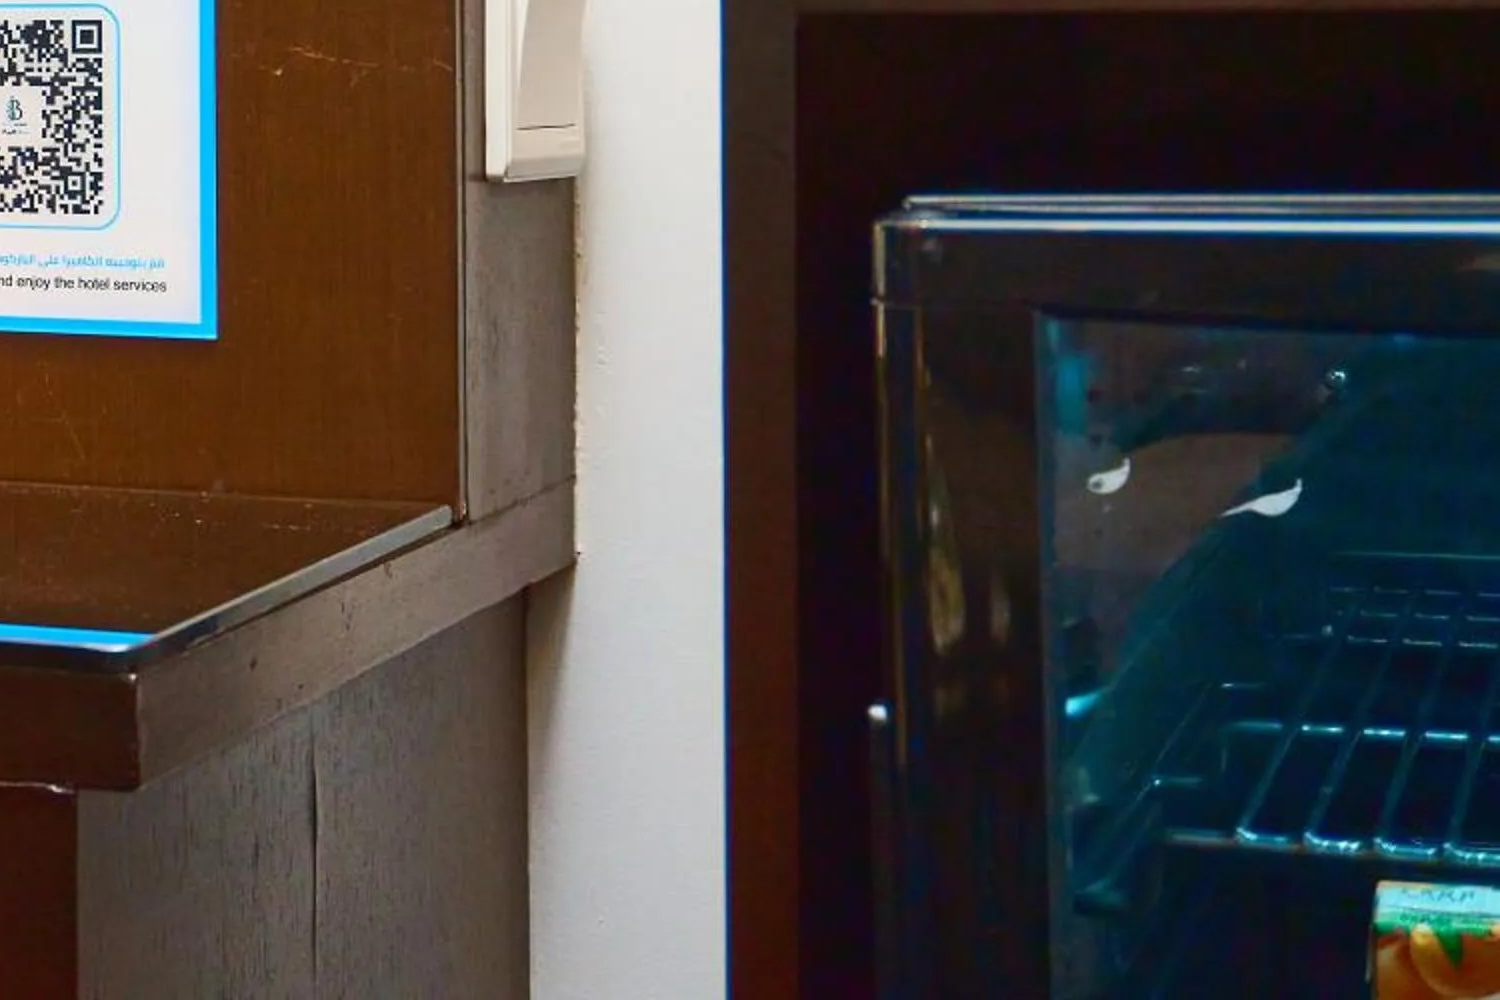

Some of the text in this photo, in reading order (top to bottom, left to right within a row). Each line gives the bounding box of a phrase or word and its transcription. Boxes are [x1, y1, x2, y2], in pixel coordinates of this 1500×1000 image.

[16, 276, 51, 291] enjoy
[54, 277, 75, 289] the
[77, 277, 110, 291] hotel
[113, 280, 168, 293] services
